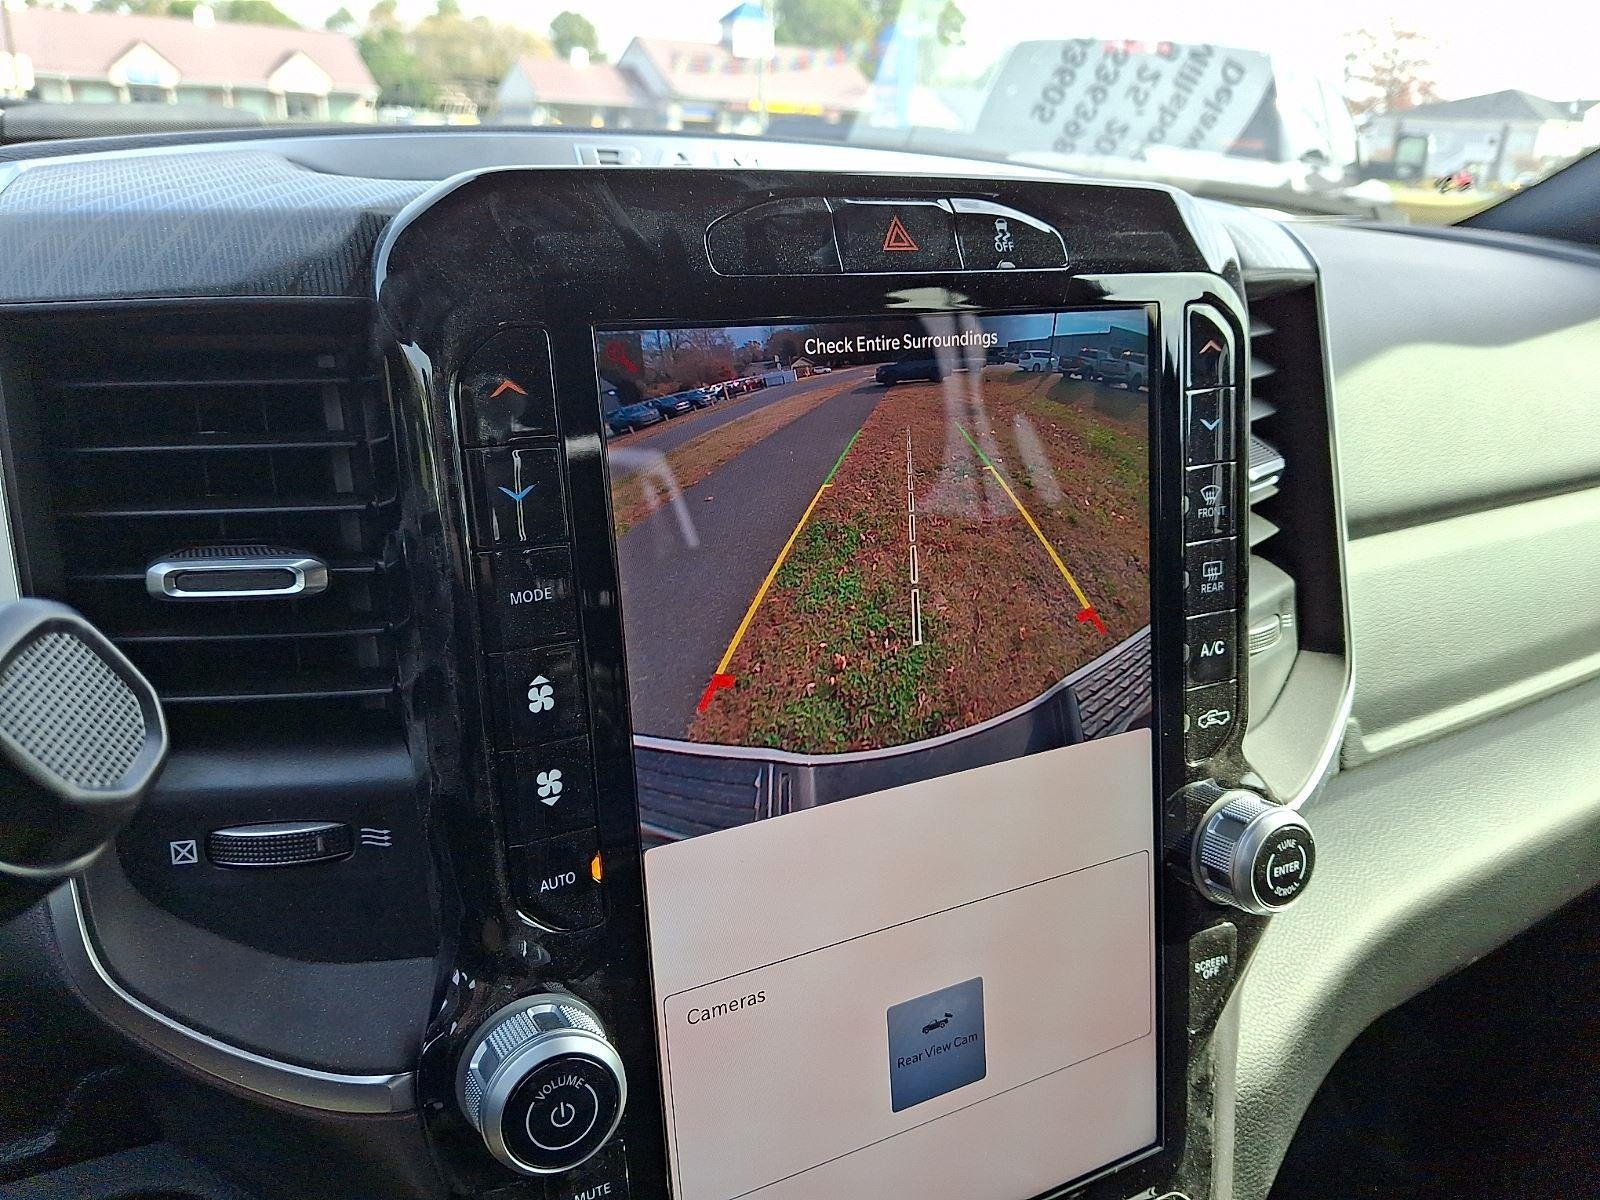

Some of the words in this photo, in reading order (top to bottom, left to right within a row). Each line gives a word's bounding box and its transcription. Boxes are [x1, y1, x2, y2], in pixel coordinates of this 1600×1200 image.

[994, 241, 1015, 252] OFF
[804, 336, 853, 355] Check
[856, 336, 900, 352] Entire
[903, 330, 998, 350] Surroundings
[1197, 505, 1227, 519] FRONT
[510, 586, 553, 605] MODE
[1200, 581, 1225, 594] REAR
[1200, 640, 1226, 657] A/C
[1276, 838, 1297, 852] TUNE
[1273, 859, 1301, 878] ENTER
[539, 871, 577, 893] AUTO
[1274, 882, 1300, 897] SCROLL
[1194, 956, 1228, 973] SCREEN
[1202, 966, 1220, 980] OFF
[686, 988, 767, 1026] Cameras
[897, 1052, 923, 1069] Rear
[924, 1043, 952, 1059] View
[953, 1032, 978, 1048] Cam
[535, 1074, 585, 1101] VOLUME
[574, 1182, 611, 1200] MUTE
